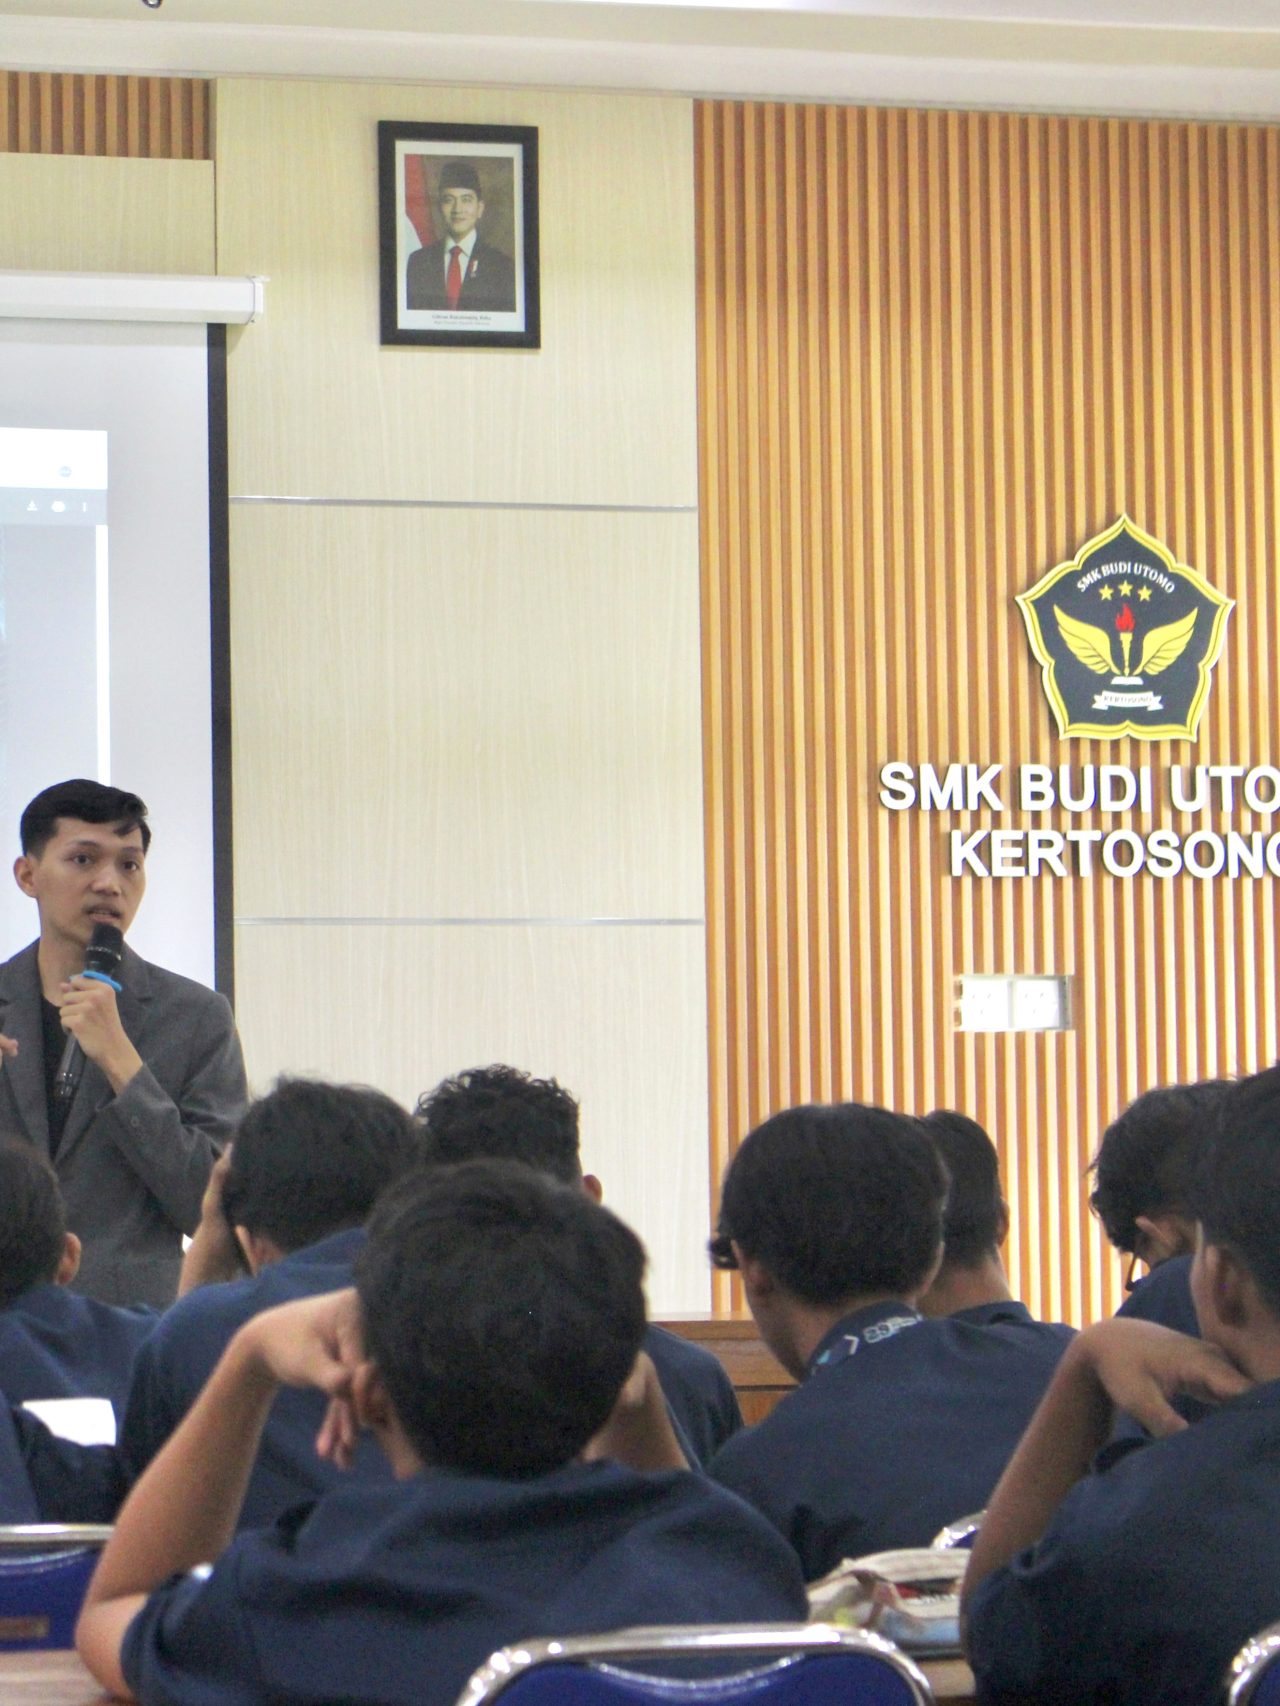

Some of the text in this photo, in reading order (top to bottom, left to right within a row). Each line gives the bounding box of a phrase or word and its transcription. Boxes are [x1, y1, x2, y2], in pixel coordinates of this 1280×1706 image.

[1077, 562, 1175, 593] SMK BUDI UTOMO
[879, 763, 1004, 811] SMK
[1021, 764, 1151, 812] BUDI
